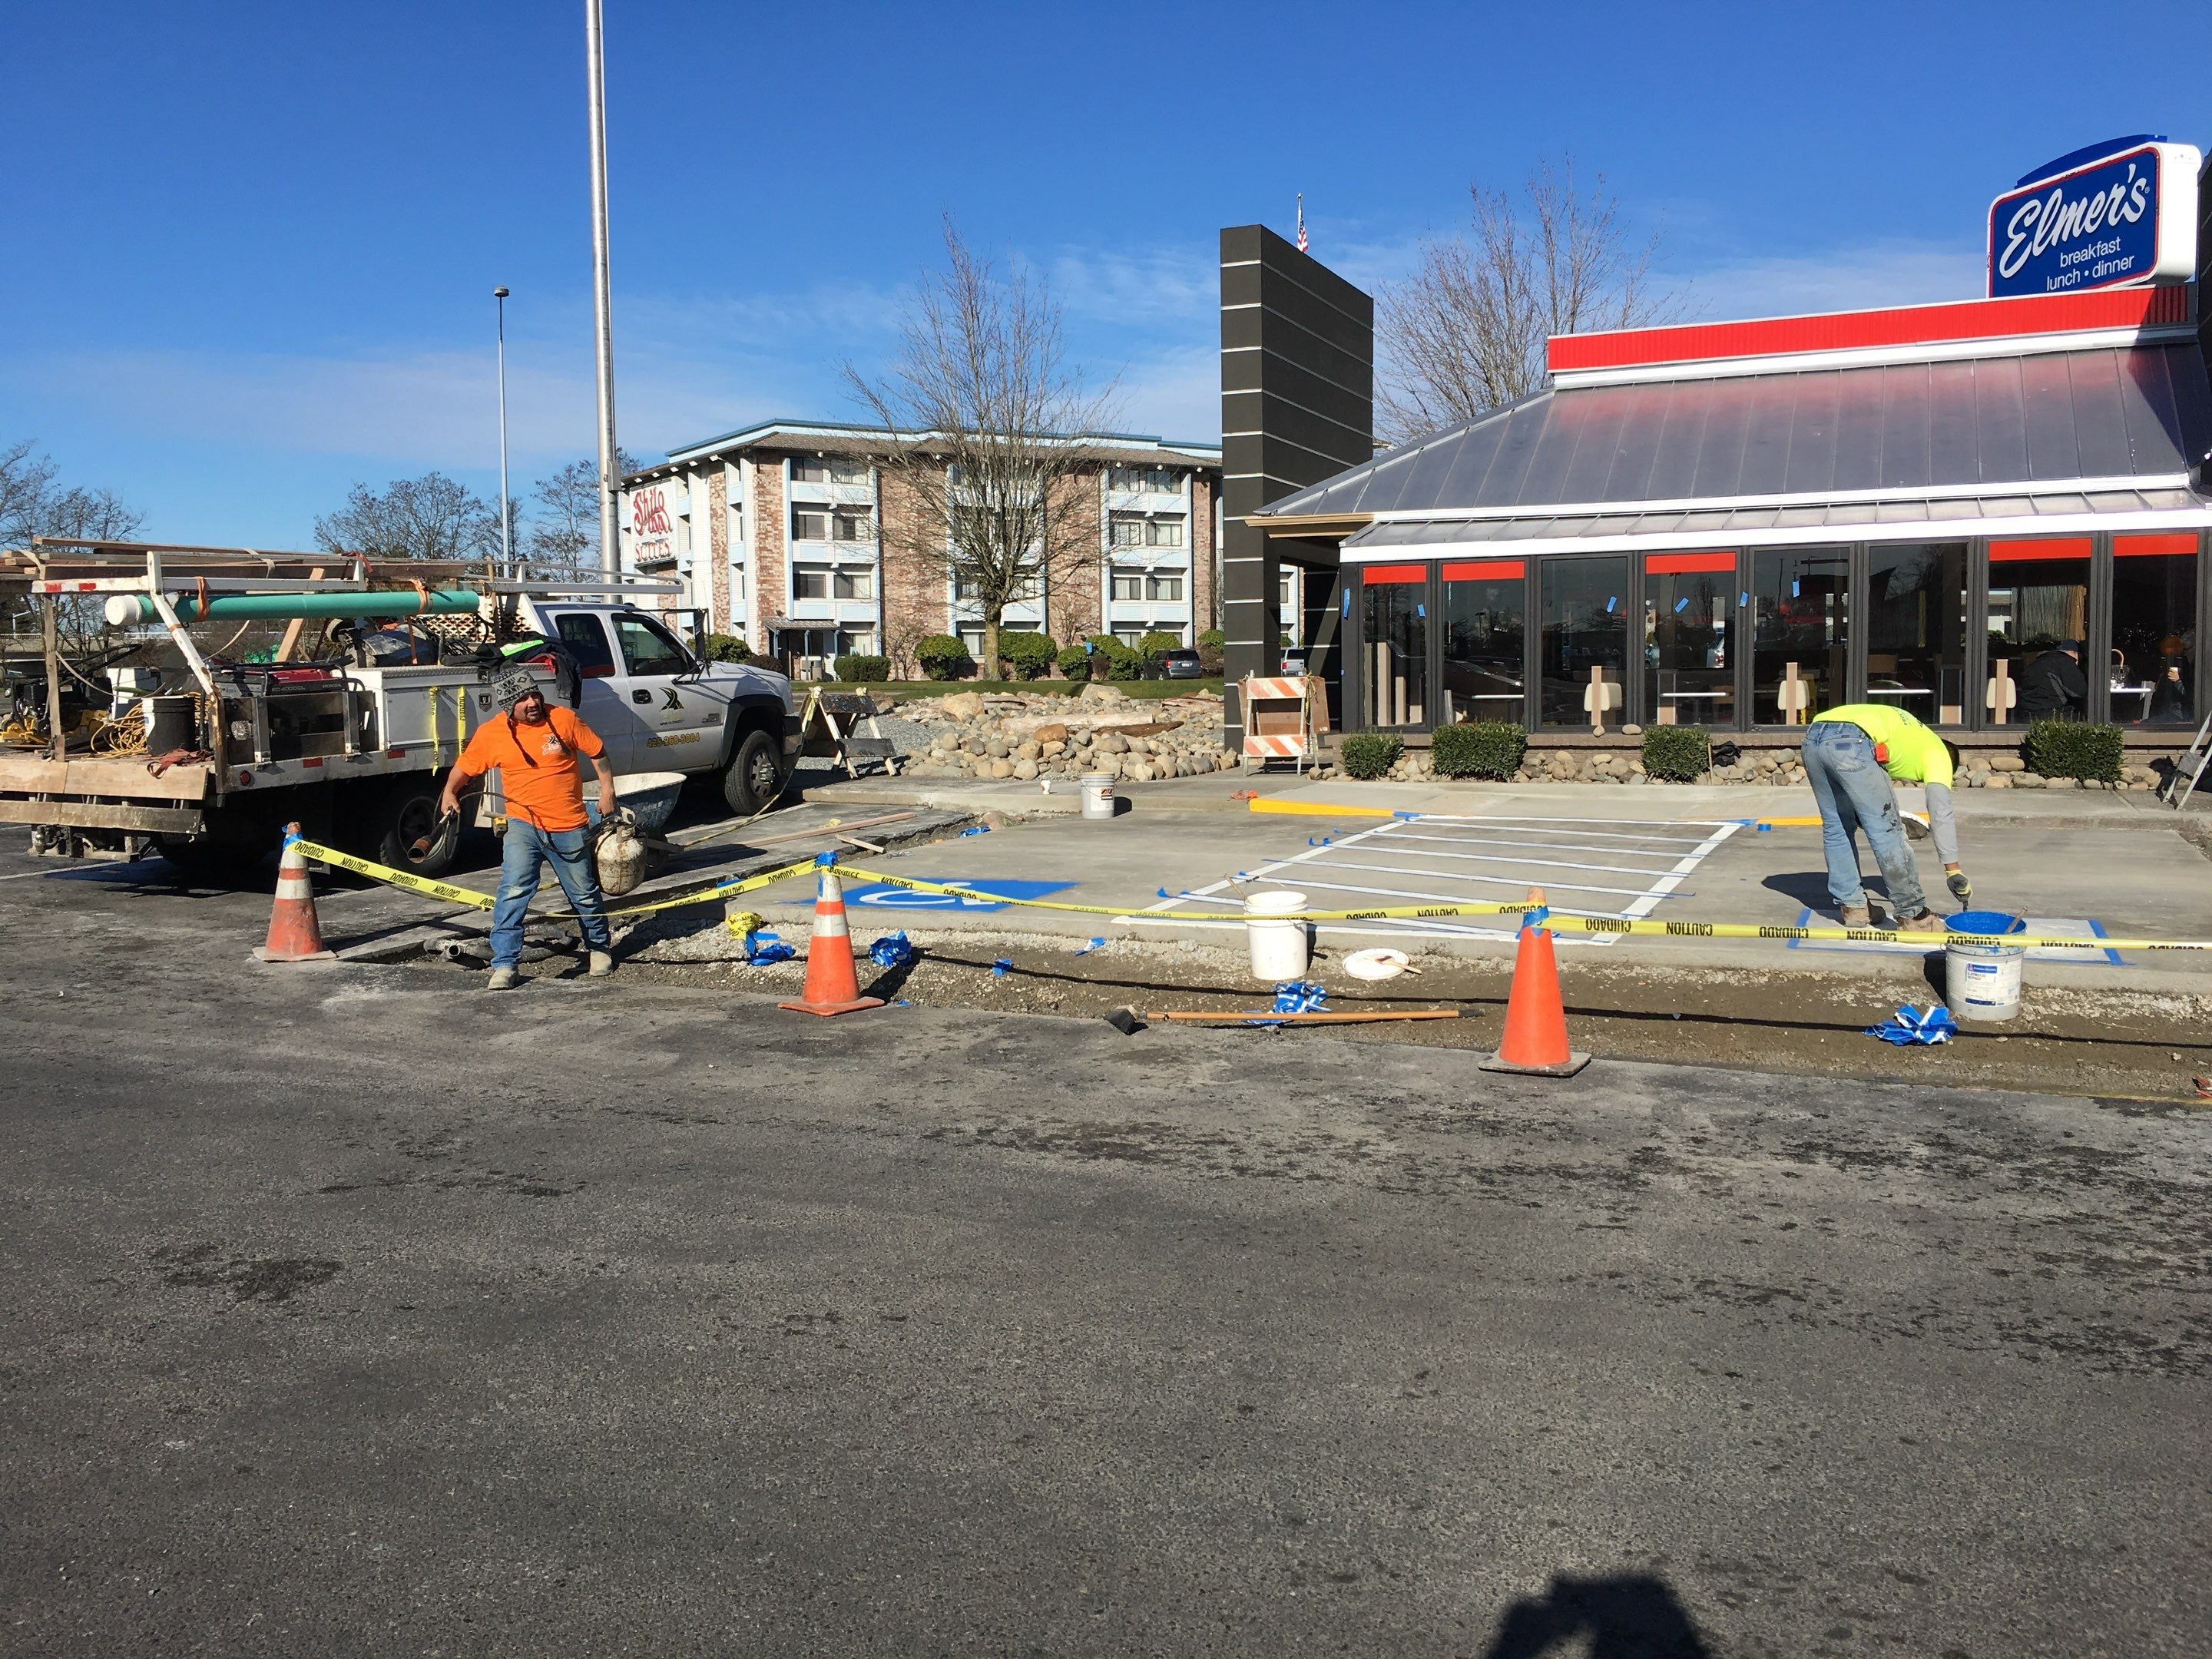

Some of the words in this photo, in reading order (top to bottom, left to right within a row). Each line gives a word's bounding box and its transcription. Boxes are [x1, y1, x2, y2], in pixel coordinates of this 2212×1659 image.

[1999, 164, 2147, 279] Elmer's
[2046, 264, 2081, 291] lunch
[2092, 254, 2135, 278] dinner
[2060, 236, 2121, 268] breakfast
[634, 486, 669, 536] Shilo
[295, 842, 324, 858] CUIDADO
[340, 857, 369, 873] CAUTION
[389, 873, 419, 886] CUIDADO
[432, 885, 461, 899] CAUTION
[1585, 919, 1631, 932] CUIDADO
[1666, 922, 1713, 936] CAUTION
[1759, 926, 1809, 939] CUIDADO
[1846, 930, 1897, 942] CAUTION
